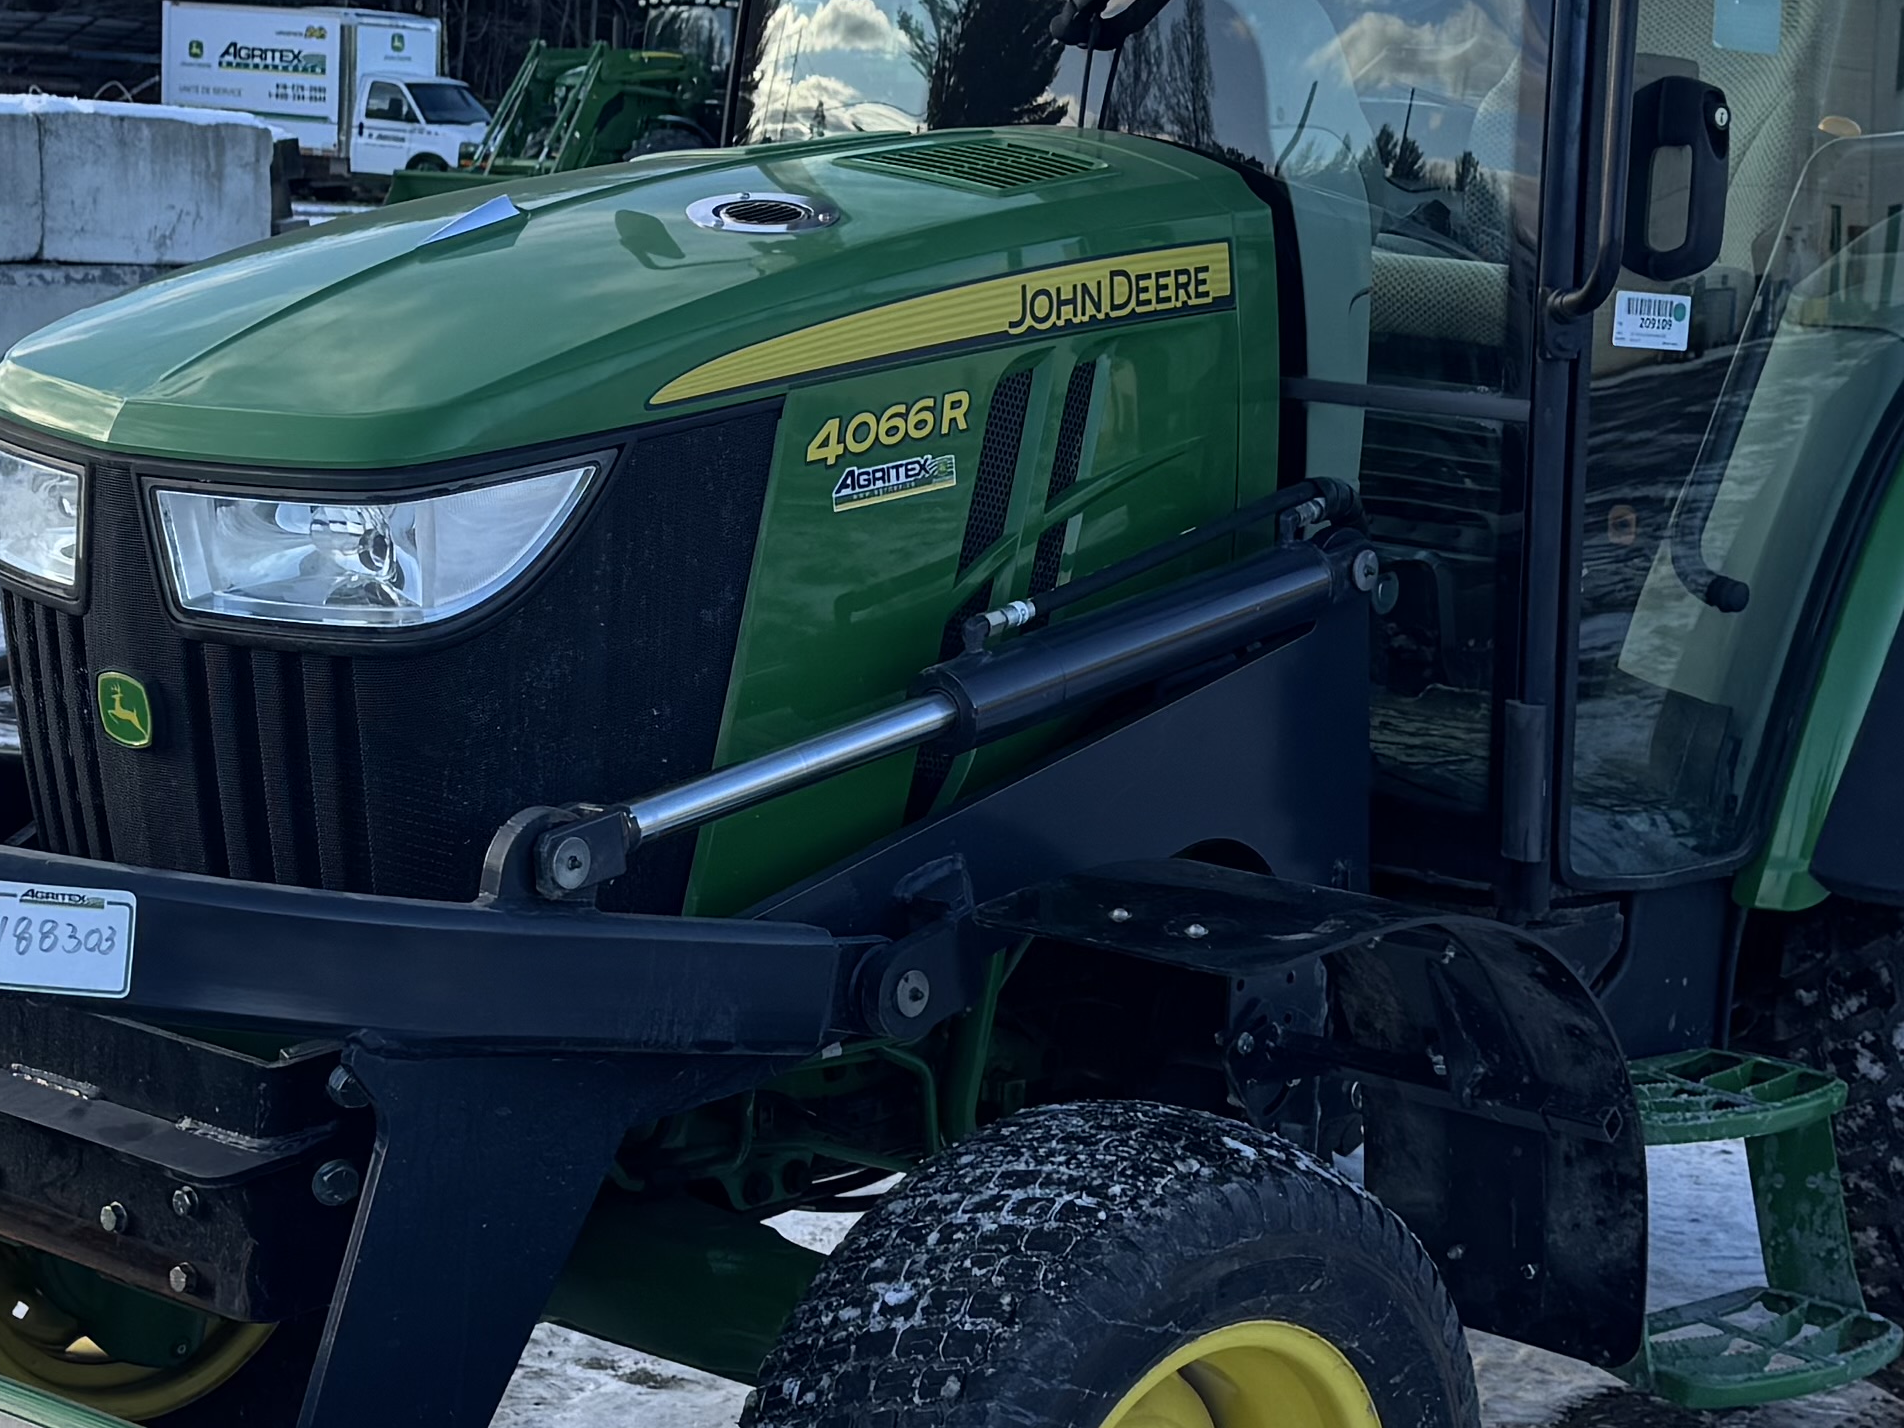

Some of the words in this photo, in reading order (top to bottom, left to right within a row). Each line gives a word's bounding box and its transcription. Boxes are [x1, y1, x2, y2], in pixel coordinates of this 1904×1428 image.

[218, 41, 303, 64] AGRITEX
[1007, 281, 1103, 334] JOHN
[1108, 265, 1212, 318] DEERE
[805, 390, 970, 466] 4066R
[834, 457, 932, 495] AGRITEX
[20, 888, 91, 904] AGRITEX
